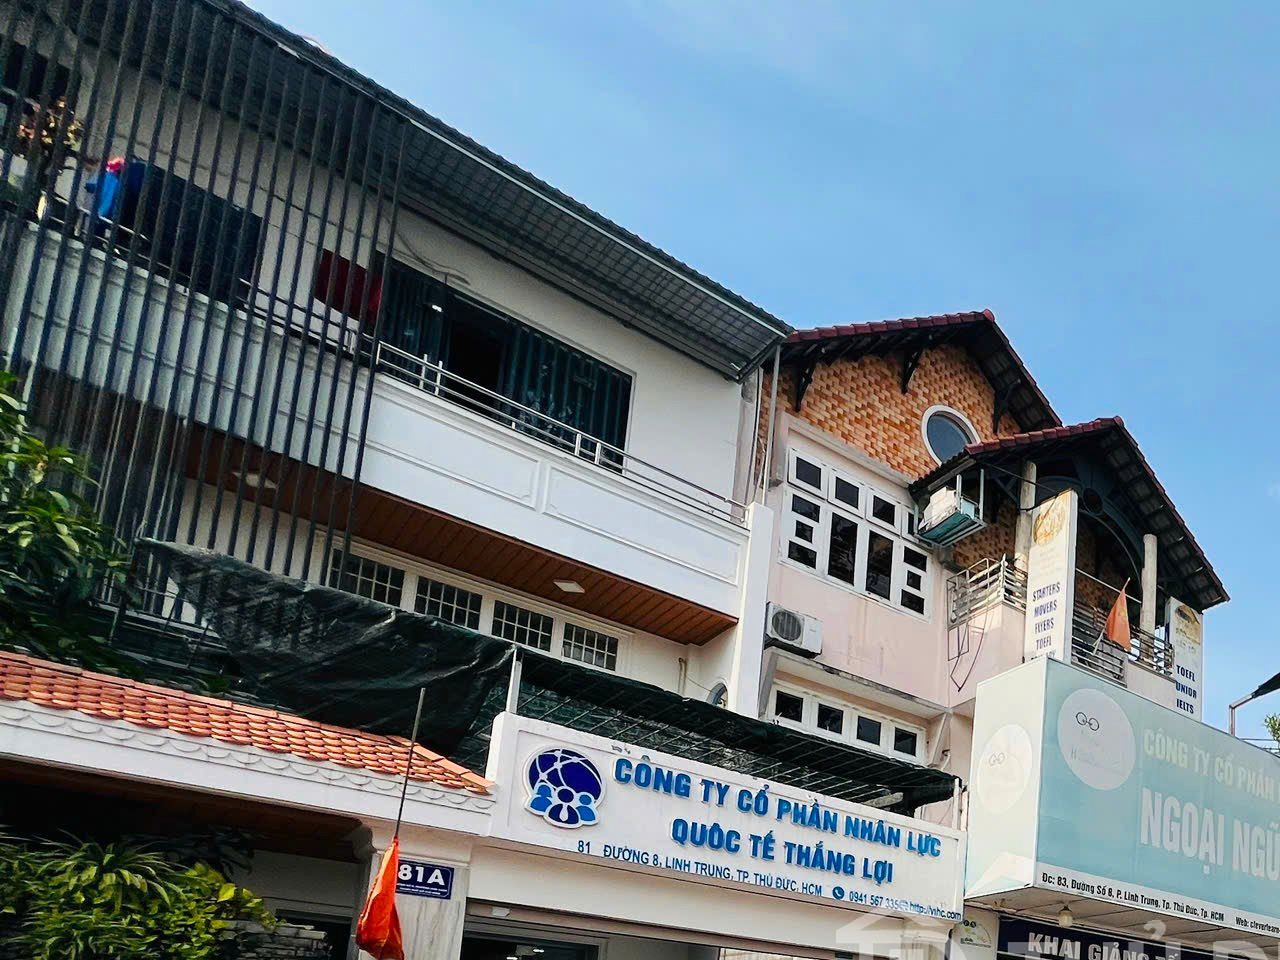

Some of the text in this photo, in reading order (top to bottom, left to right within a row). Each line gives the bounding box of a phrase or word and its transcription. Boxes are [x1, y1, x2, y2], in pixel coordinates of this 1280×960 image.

[1032, 581, 1061, 602] STARTERS
[1034, 601, 1057, 618] MOVERS
[1034, 617, 1055, 635] FLYERS
[1176, 664, 1196, 682] TOEFL
[1176, 698, 1195, 715] IELTS
[1143, 728, 1188, 769] CÔNG
[1193, 747, 1210, 777] TY
[614, 754, 691, 798] CÔNG
[699, 779, 730, 807] TY
[737, 784, 769, 817] CỔ
[844, 815, 901, 848] NHÂN
[906, 830, 942, 858] LỰC
[1140, 787, 1225, 875] NGOẠI
[577, 840, 591, 855] 81
[603, 842, 649, 865] ĐƯỜNG
[652, 854, 662, 868] 8,
[665, 856, 691, 872] LINH
[694, 861, 734, 881] TRUNG,
[736, 869, 750, 884] TP.
[754, 872, 773, 889] THỦ
[801, 883, 823, 897] HCM
[748, 830, 776, 860] TẾ
[783, 841, 856, 876] THẮNG
[861, 857, 894, 886] LỢI
[398, 864, 446, 886] 81A
[849, 890, 868, 904] 0941
[870, 893, 884, 906] 567
[1056, 875, 1069, 889] 83,
[1116, 890, 1123, 900] P.
[1124, 891, 1139, 903] Linh
[1140, 894, 1161, 908] Trung,
[1028, 932, 1081, 960] KHAI
